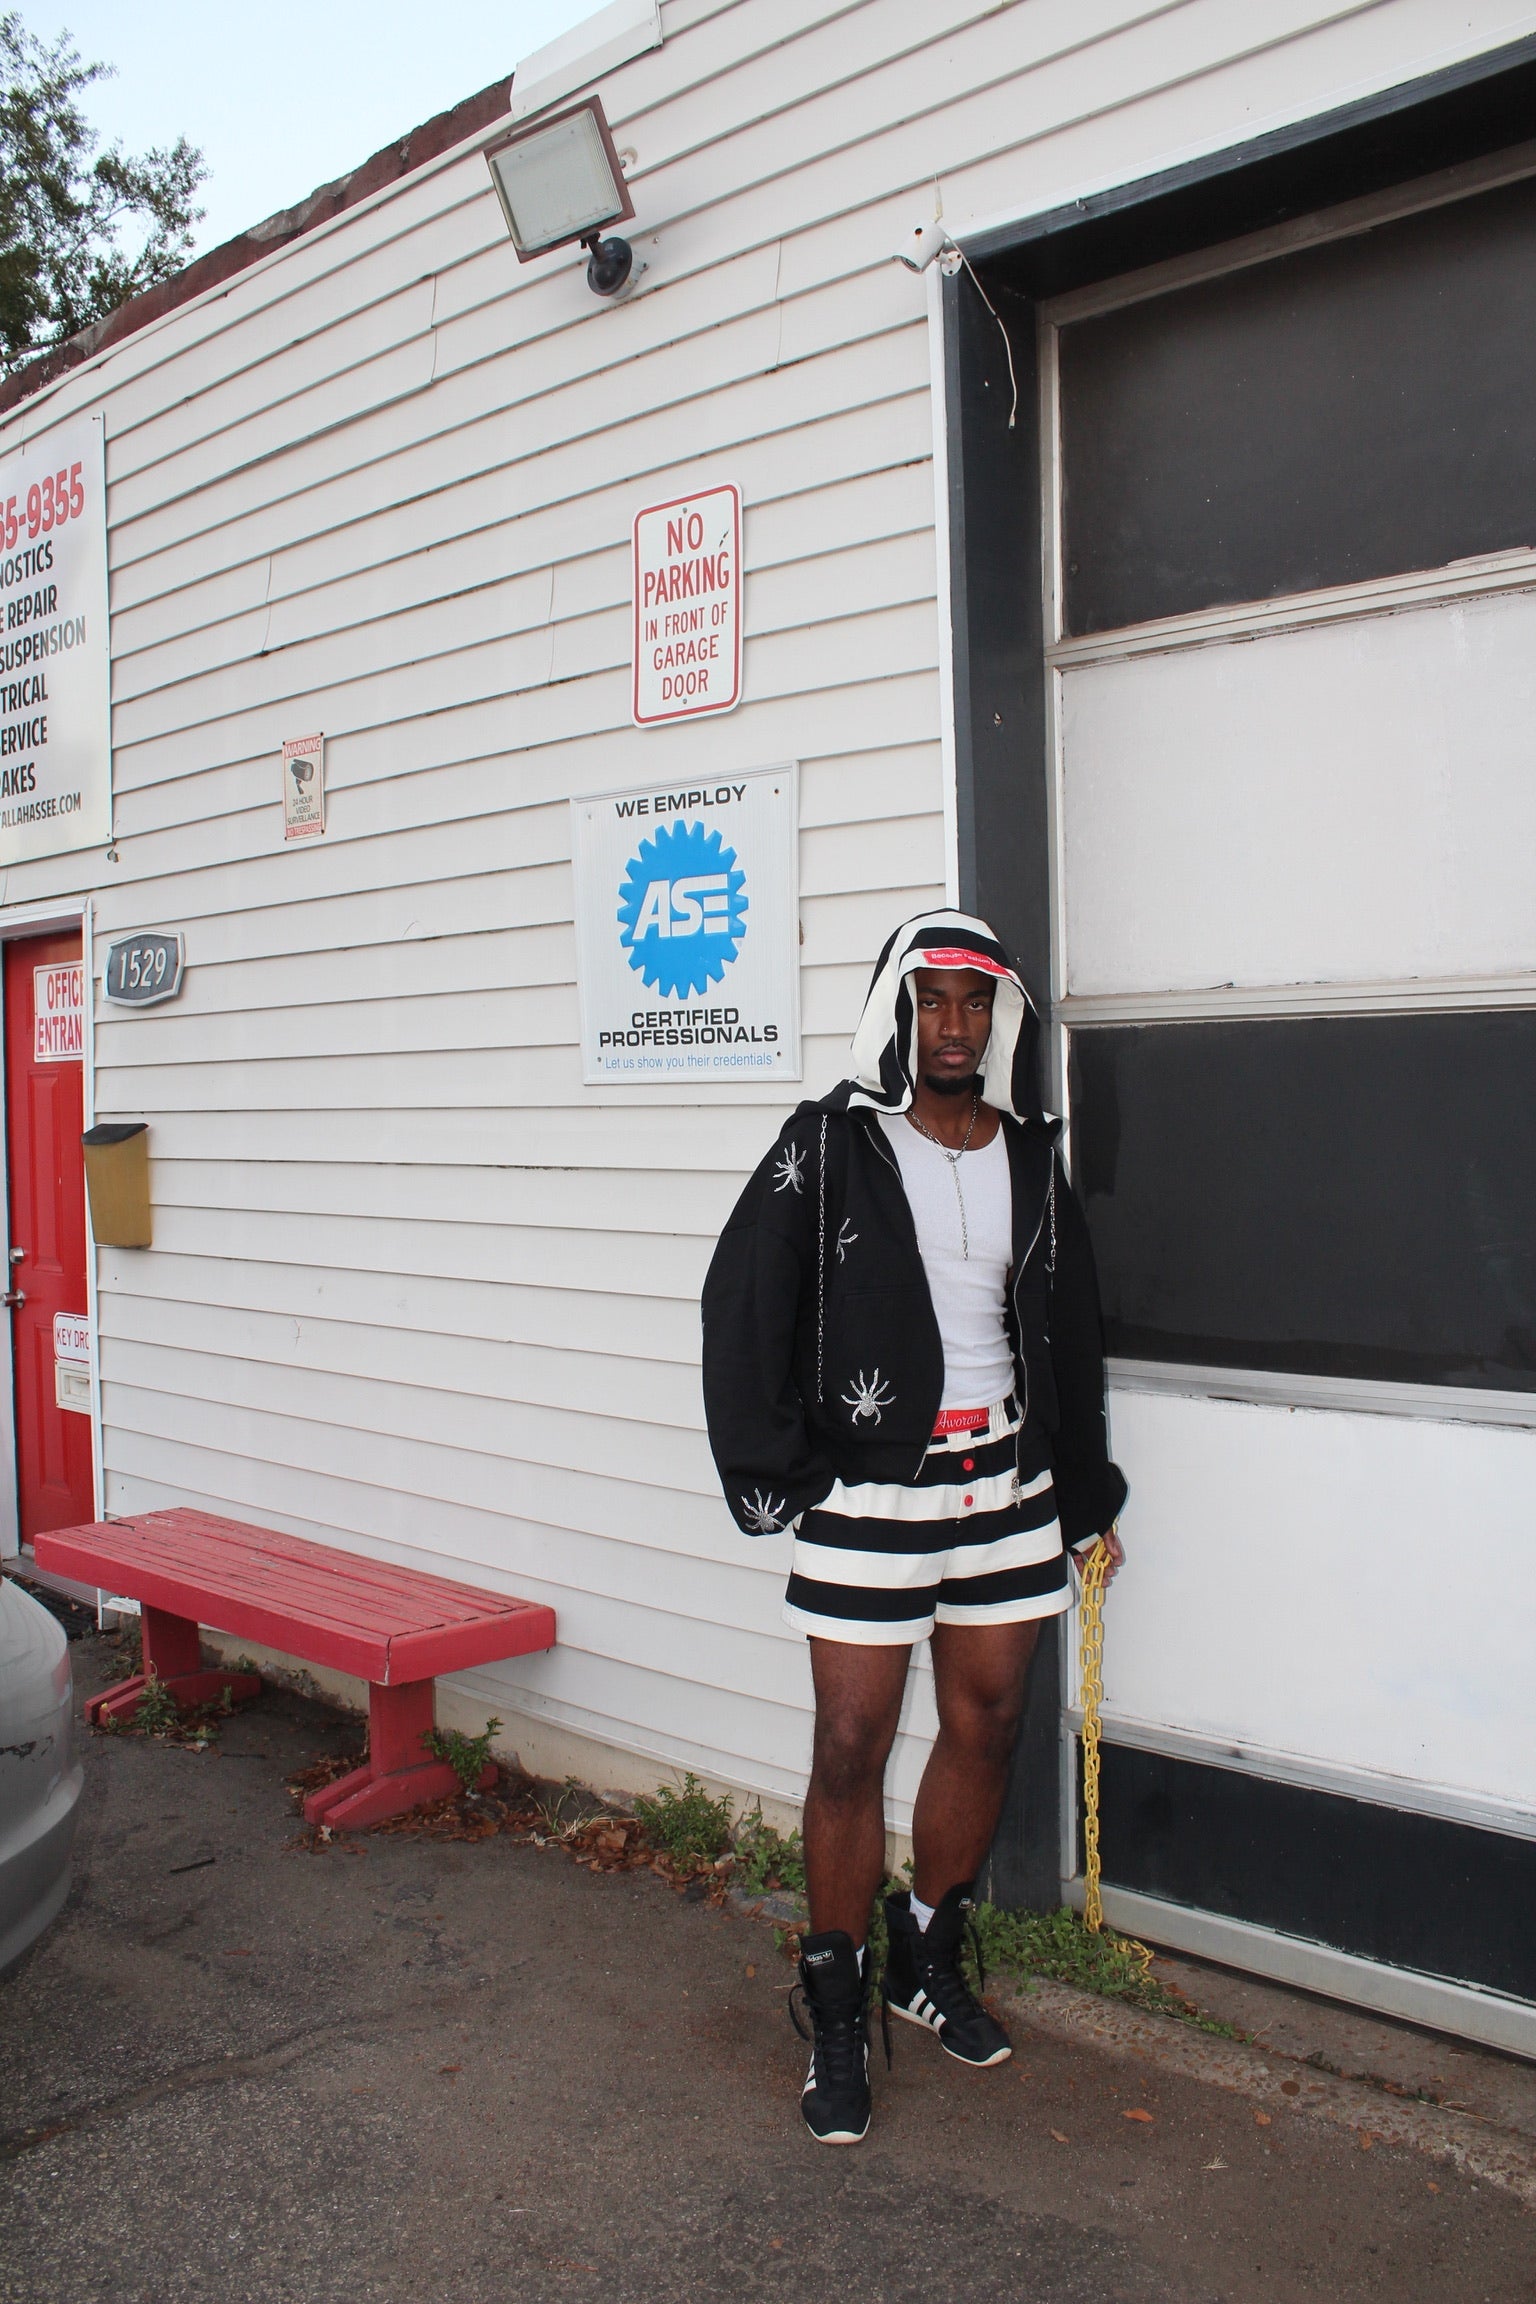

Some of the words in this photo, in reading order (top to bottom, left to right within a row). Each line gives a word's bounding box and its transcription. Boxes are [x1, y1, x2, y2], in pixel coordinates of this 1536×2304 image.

[667, 513, 703, 557] NO
[644, 551, 730, 608] PARKING
[8, 584, 58, 631] REPAIR
[646, 619, 657, 642] IN
[665, 607, 705, 637] FRONT
[711, 602, 728, 627] OF
[0, 615, 86, 675] SUSPENSION
[653, 634, 720, 671] GARAGE
[662, 669, 709, 701] DOOR
[286, 738, 320, 757] WARNING
[0, 762, 36, 799] AKES
[0, 792, 81, 829] ALLAHASSEE.COM
[287, 811, 320, 826] SURVEILLANCE
[296, 805, 310, 814] VIDEO
[298, 795, 313, 805] HOUR
[615, 799, 649, 818] WE
[654, 785, 747, 813] EMPLOY
[632, 873, 729, 940] ASE
[120, 947, 167, 990] 1529
[38, 1014, 82, 1053] ENTRAN
[631, 1007, 739, 1028] CERTIFIED
[599, 1025, 778, 1048] PROFESSIONALS
[605, 1057, 620, 1069] Let
[623, 1058, 635, 1068] us
[637, 1055, 664, 1068] show
[666, 1057, 685, 1071] you
[687, 1054, 710, 1067] their
[713, 1052, 773, 1066] credentials
[56, 1327, 72, 1346] KEY
